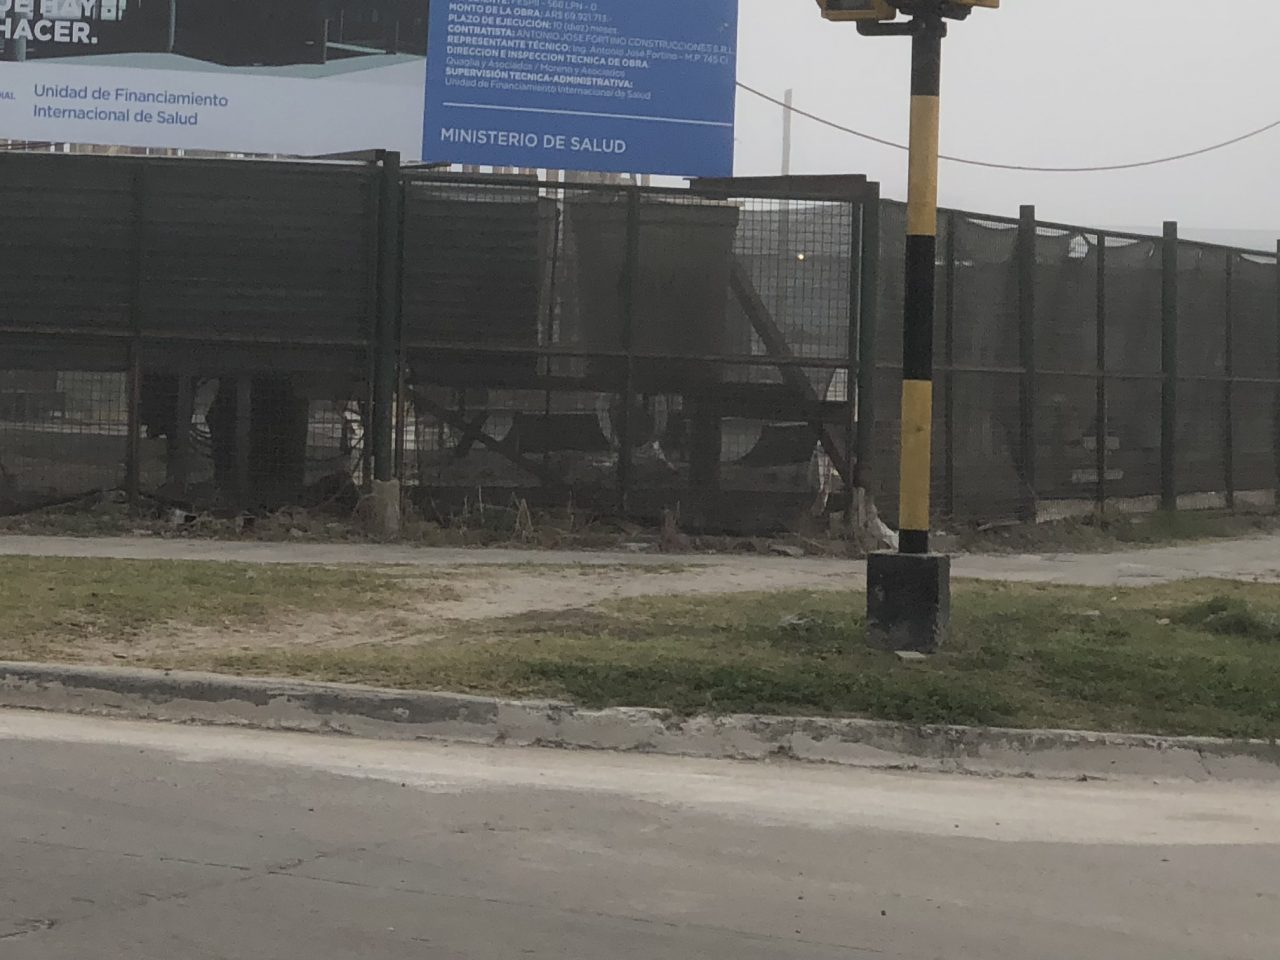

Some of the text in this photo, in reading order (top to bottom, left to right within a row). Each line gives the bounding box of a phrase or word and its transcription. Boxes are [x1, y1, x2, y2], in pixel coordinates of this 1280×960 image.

[449, 3, 484, 13] MONTO
[485, 5, 498, 14] DE
[500, 6, 511, 15] LA
[513, 7, 542, 17] OBRA:
[448, 14, 480, 23] PLAZO
[481, 15, 495, 24] DE
[447, 24, 515, 37] CONTRATISTA:
[516, 29, 559, 40] ANTONIO
[447, 35, 526, 49] REPRESENTANTE
[500, 50, 507, 58] E
[608, 57, 620, 66] DE
[33, 84, 229, 107] Unidad de Financiamiento
[444, 78, 477, 88] Unidad
[477, 79, 489, 88] de
[490, 80, 557, 94] Financiamiento
[614, 89, 626, 98] de
[33, 105, 198, 126] Internacional de Salud
[441, 127, 627, 154] MINISTERIO DE SALUD
